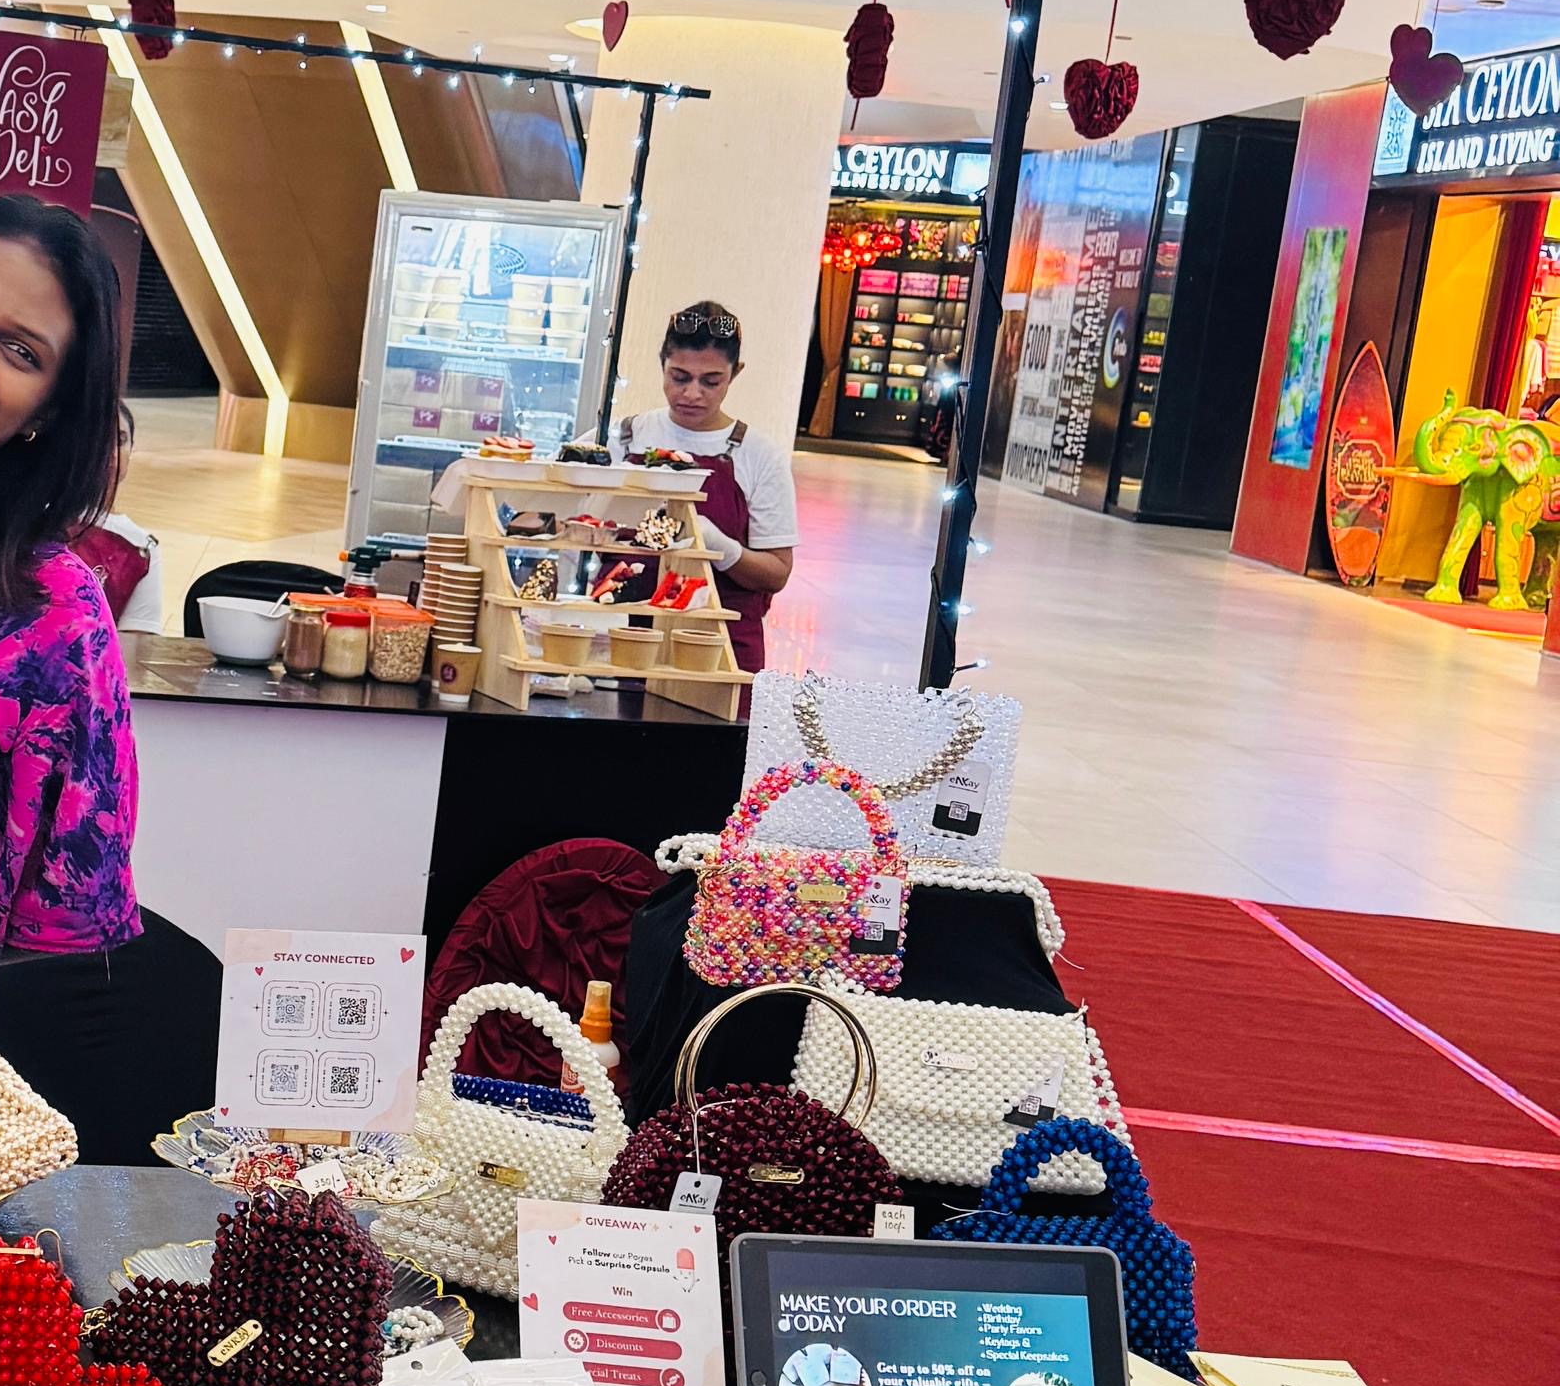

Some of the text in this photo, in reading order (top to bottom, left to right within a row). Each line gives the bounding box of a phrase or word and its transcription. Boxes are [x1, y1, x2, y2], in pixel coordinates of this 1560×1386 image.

[1466, 53, 1560, 124] CEYLON
[1416, 127, 1557, 173] ISLAND LIVING
[847, 144, 950, 179] CEYLON
[830, 171, 902, 191] LLNESS
[1048, 209, 1100, 470] ENTERTAINME
[273, 952, 375, 966] STAY CONNECTED
[881, 1210, 906, 1220] each
[586, 1217, 647, 1231] GIVEAWAY
[582, 1248, 611, 1258] Follow
[595, 1259, 631, 1271] Surprise
[633, 1263, 670, 1274] Capsule
[612, 1286, 633, 1297] Win
[779, 1294, 957, 1319] MAKE YOUR ORDER
[982, 1303, 1023, 1316] Wedding
[571, 1306, 649, 1324] Free Accessories
[782, 1314, 847, 1333] TODAY
[984, 1324, 1009, 1336] Party
[596, 1338, 644, 1352] Discounts
[986, 1350, 1069, 1363] Special Keepsakes
[588, 1366, 642, 1382] cial Treats
[877, 1362, 897, 1374] Get
[900, 1364, 915, 1377] up
[917, 1365, 930, 1375] to
[932, 1364, 955, 1376] 50%
